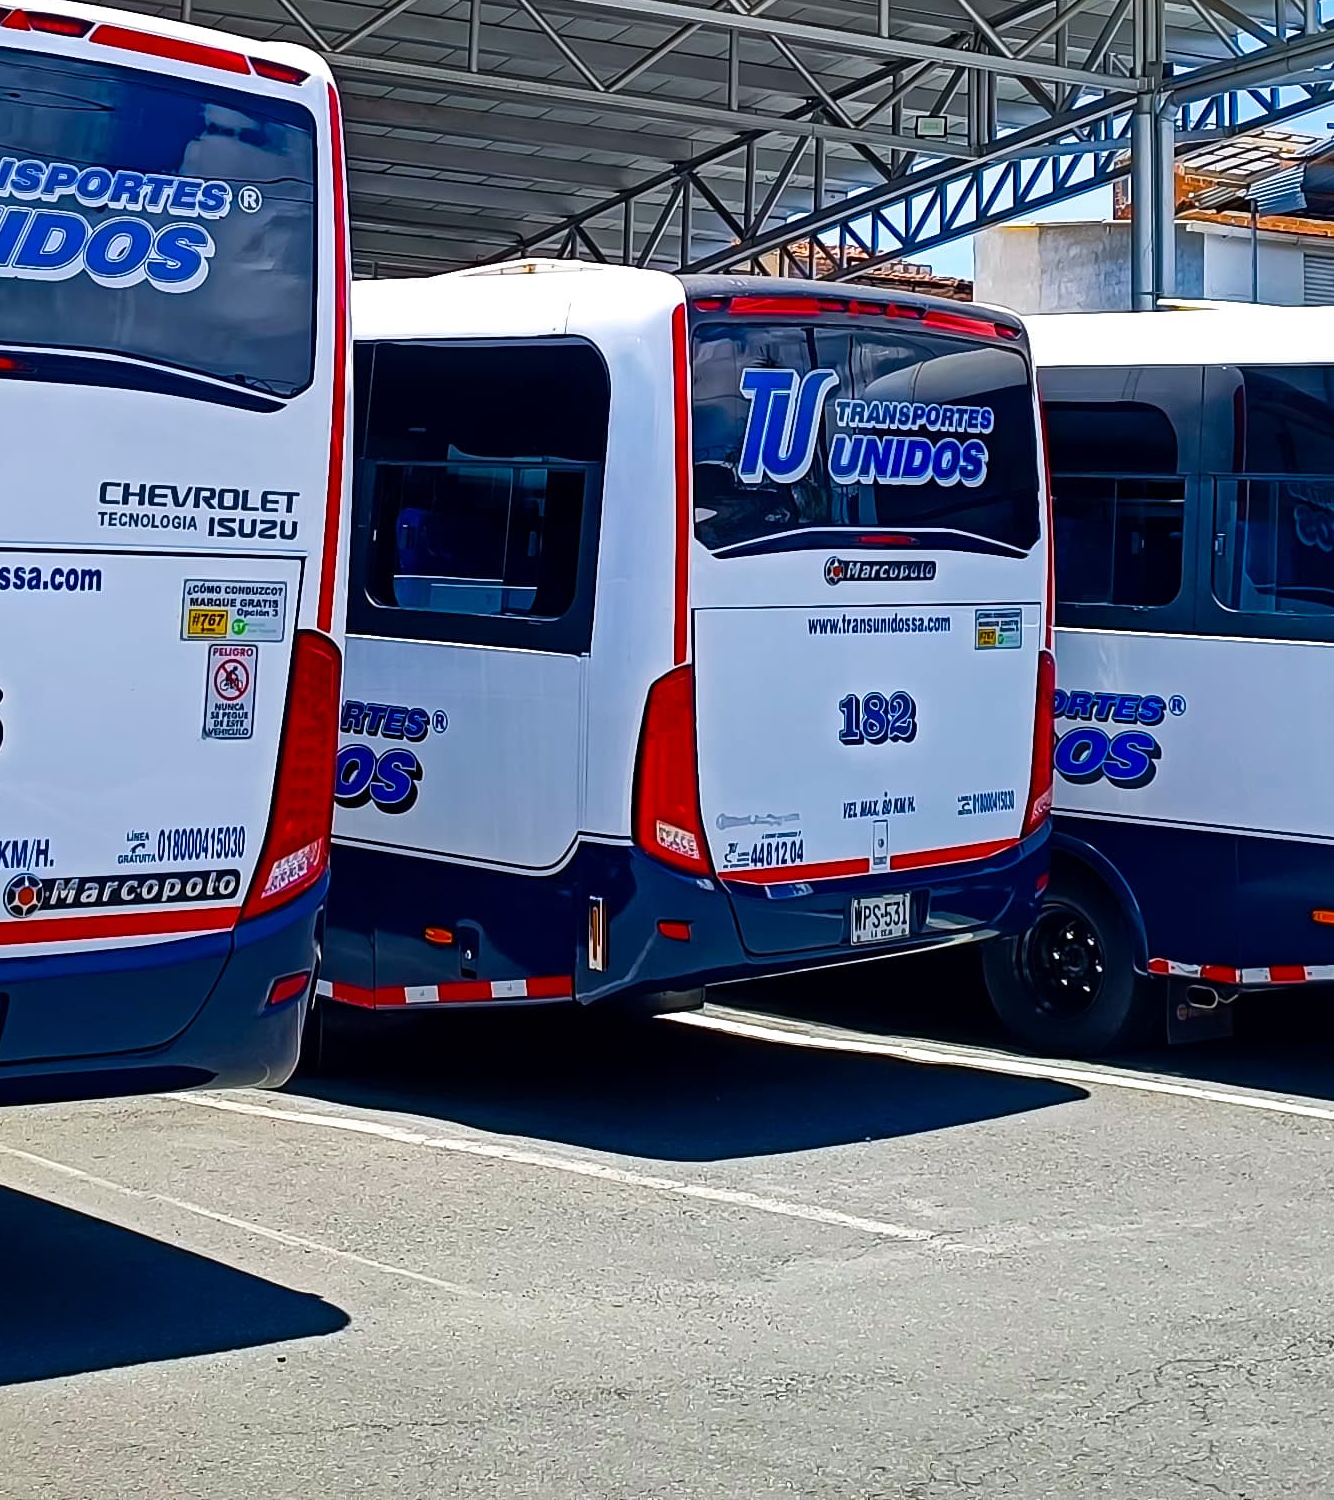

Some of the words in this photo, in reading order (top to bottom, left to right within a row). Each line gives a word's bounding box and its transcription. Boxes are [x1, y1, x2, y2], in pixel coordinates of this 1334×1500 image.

[738, 368, 839, 484] TU
[835, 399, 994, 434] TRANSPORTES
[828, 434, 988, 487] UNIDOS
[99, 481, 301, 514] CHEVROLET
[98, 511, 198, 531] TECNOLOGIA
[208, 516, 298, 540] ISUZU
[225, 585, 283, 596] CONDUZCO?
[190, 597, 236, 608] MARQUE
[240, 598, 279, 609] GRATIS
[272, 609, 279, 617] 3
[192, 613, 225, 627] #767
[808, 612, 951, 635] www.transunidossa.com
[213, 647, 254, 657] PELIGRO
[214, 703, 245, 712] NUNCA
[839, 691, 917, 745] 182
[214, 719, 224, 728] DE
[226, 720, 244, 728] ESTE
[158, 826, 245, 861] 018000415030
[118, 853, 156, 864] GRATUITA
[50, 872, 235, 906] Marcopolo
